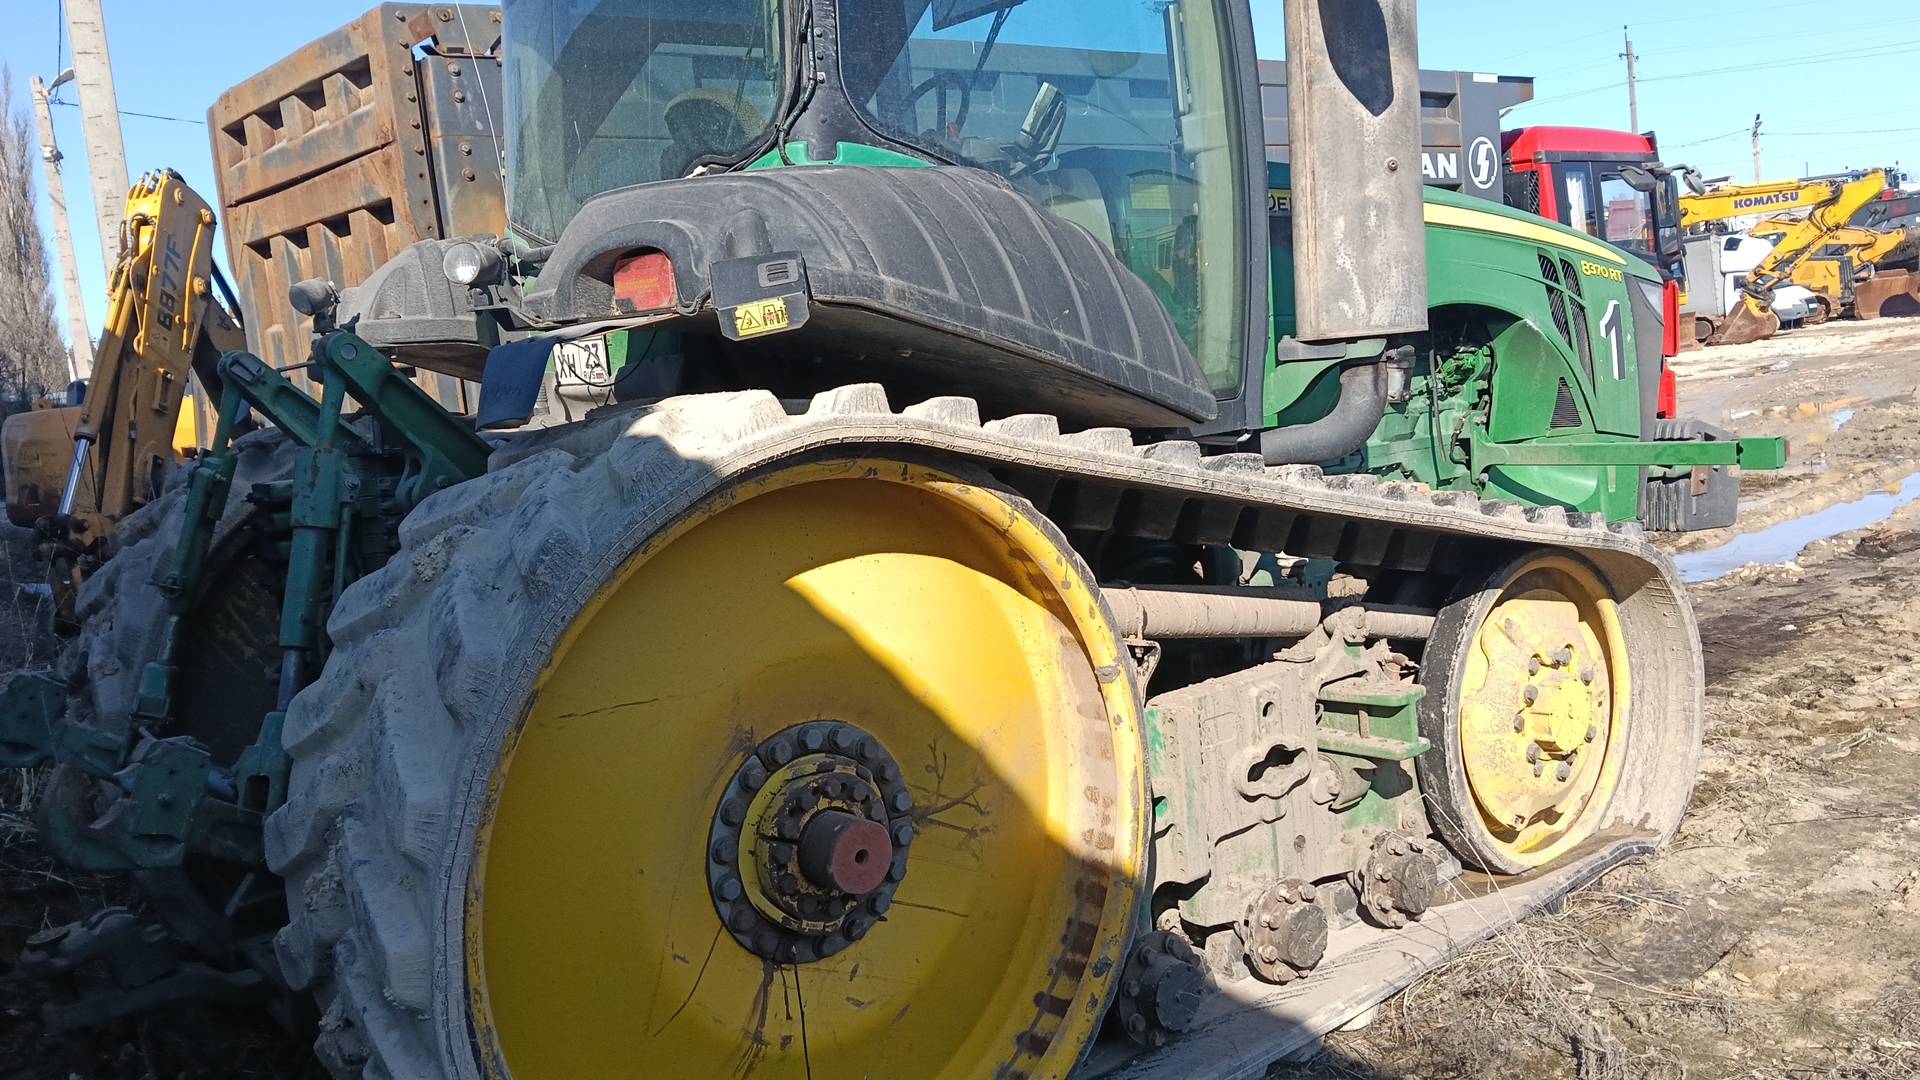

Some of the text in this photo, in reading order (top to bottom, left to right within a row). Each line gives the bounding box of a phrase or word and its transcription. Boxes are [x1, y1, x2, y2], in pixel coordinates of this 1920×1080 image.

[1734, 191, 1799, 209] KOMATSU
[1581, 260, 1623, 282] 8370 RT
[1599, 299, 1625, 380] 1
